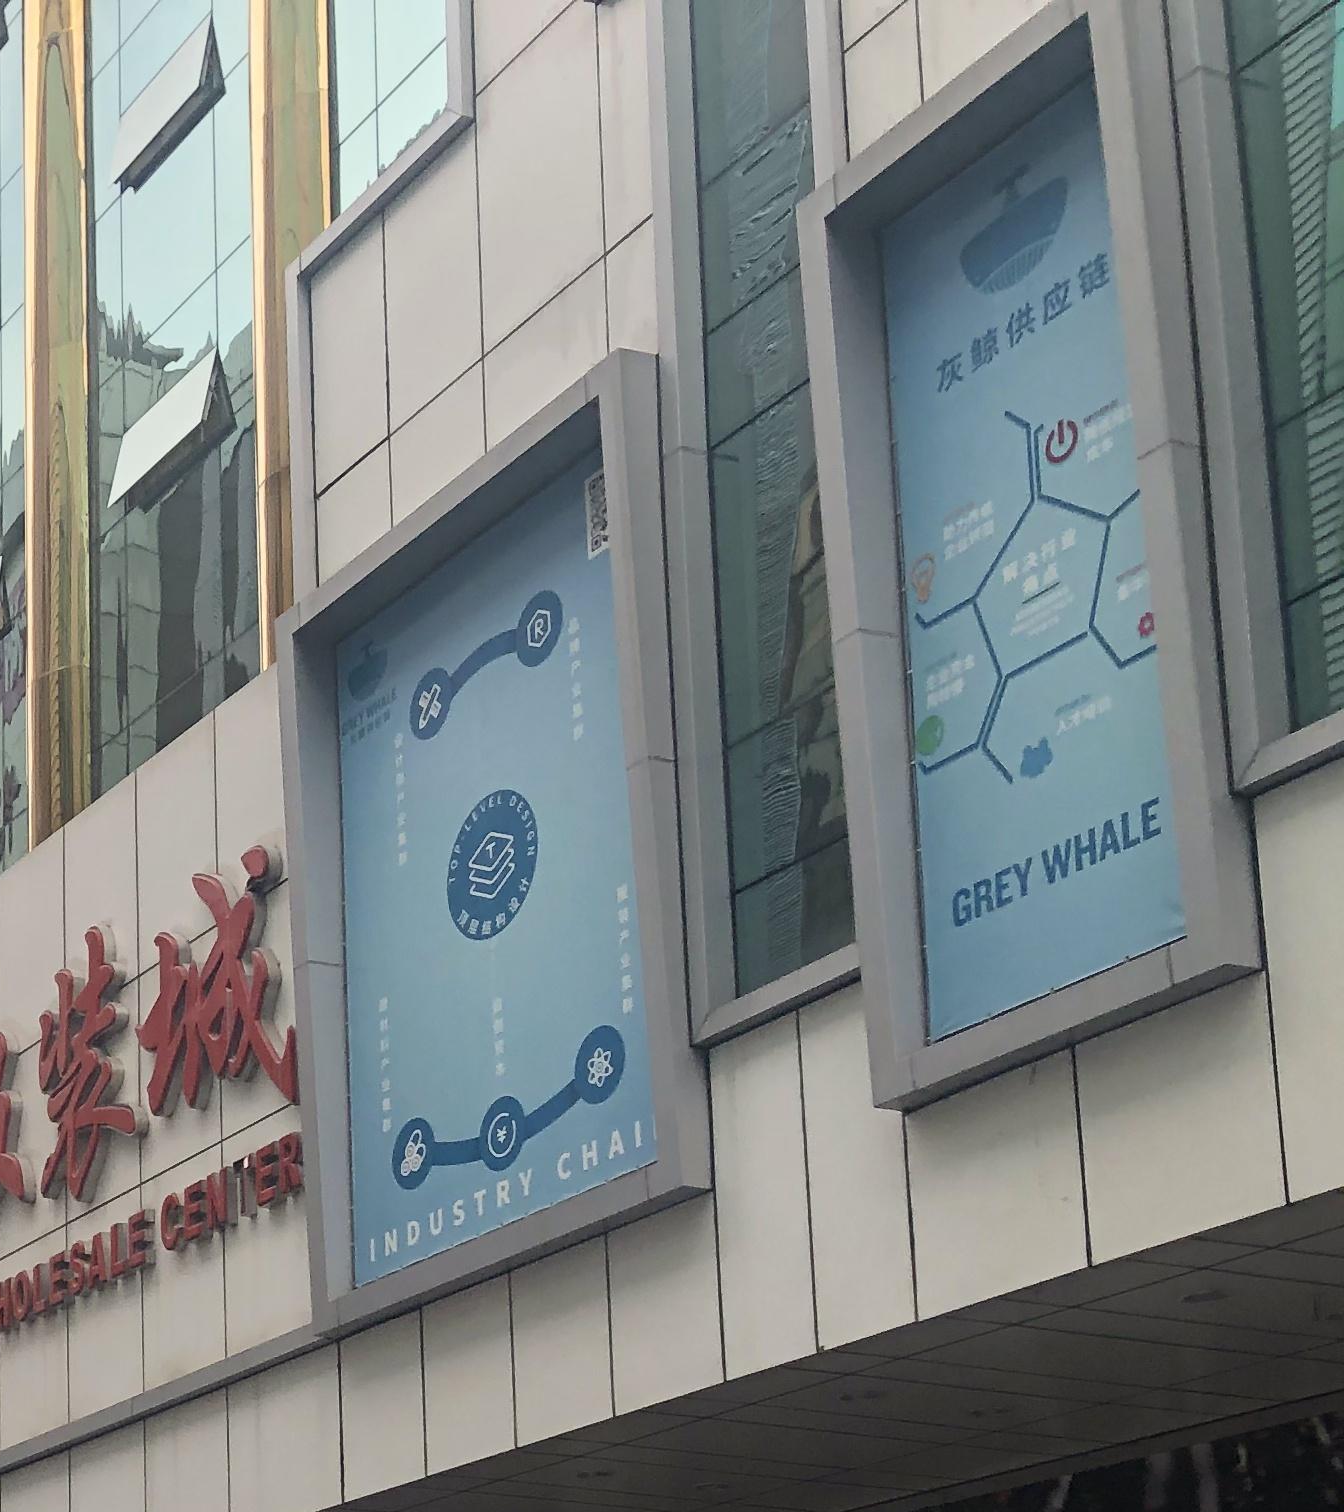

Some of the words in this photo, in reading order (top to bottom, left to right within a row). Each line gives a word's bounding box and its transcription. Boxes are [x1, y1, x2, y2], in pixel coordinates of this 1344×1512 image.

[937, 252, 1110, 393] 灰鲸供应链
[952, 856, 1033, 928] GREY
[1041, 796, 1162, 885] WHALE
[160, 1131, 305, 1250] CENTER
[369, 1168, 533, 1263] INDUSTRY
